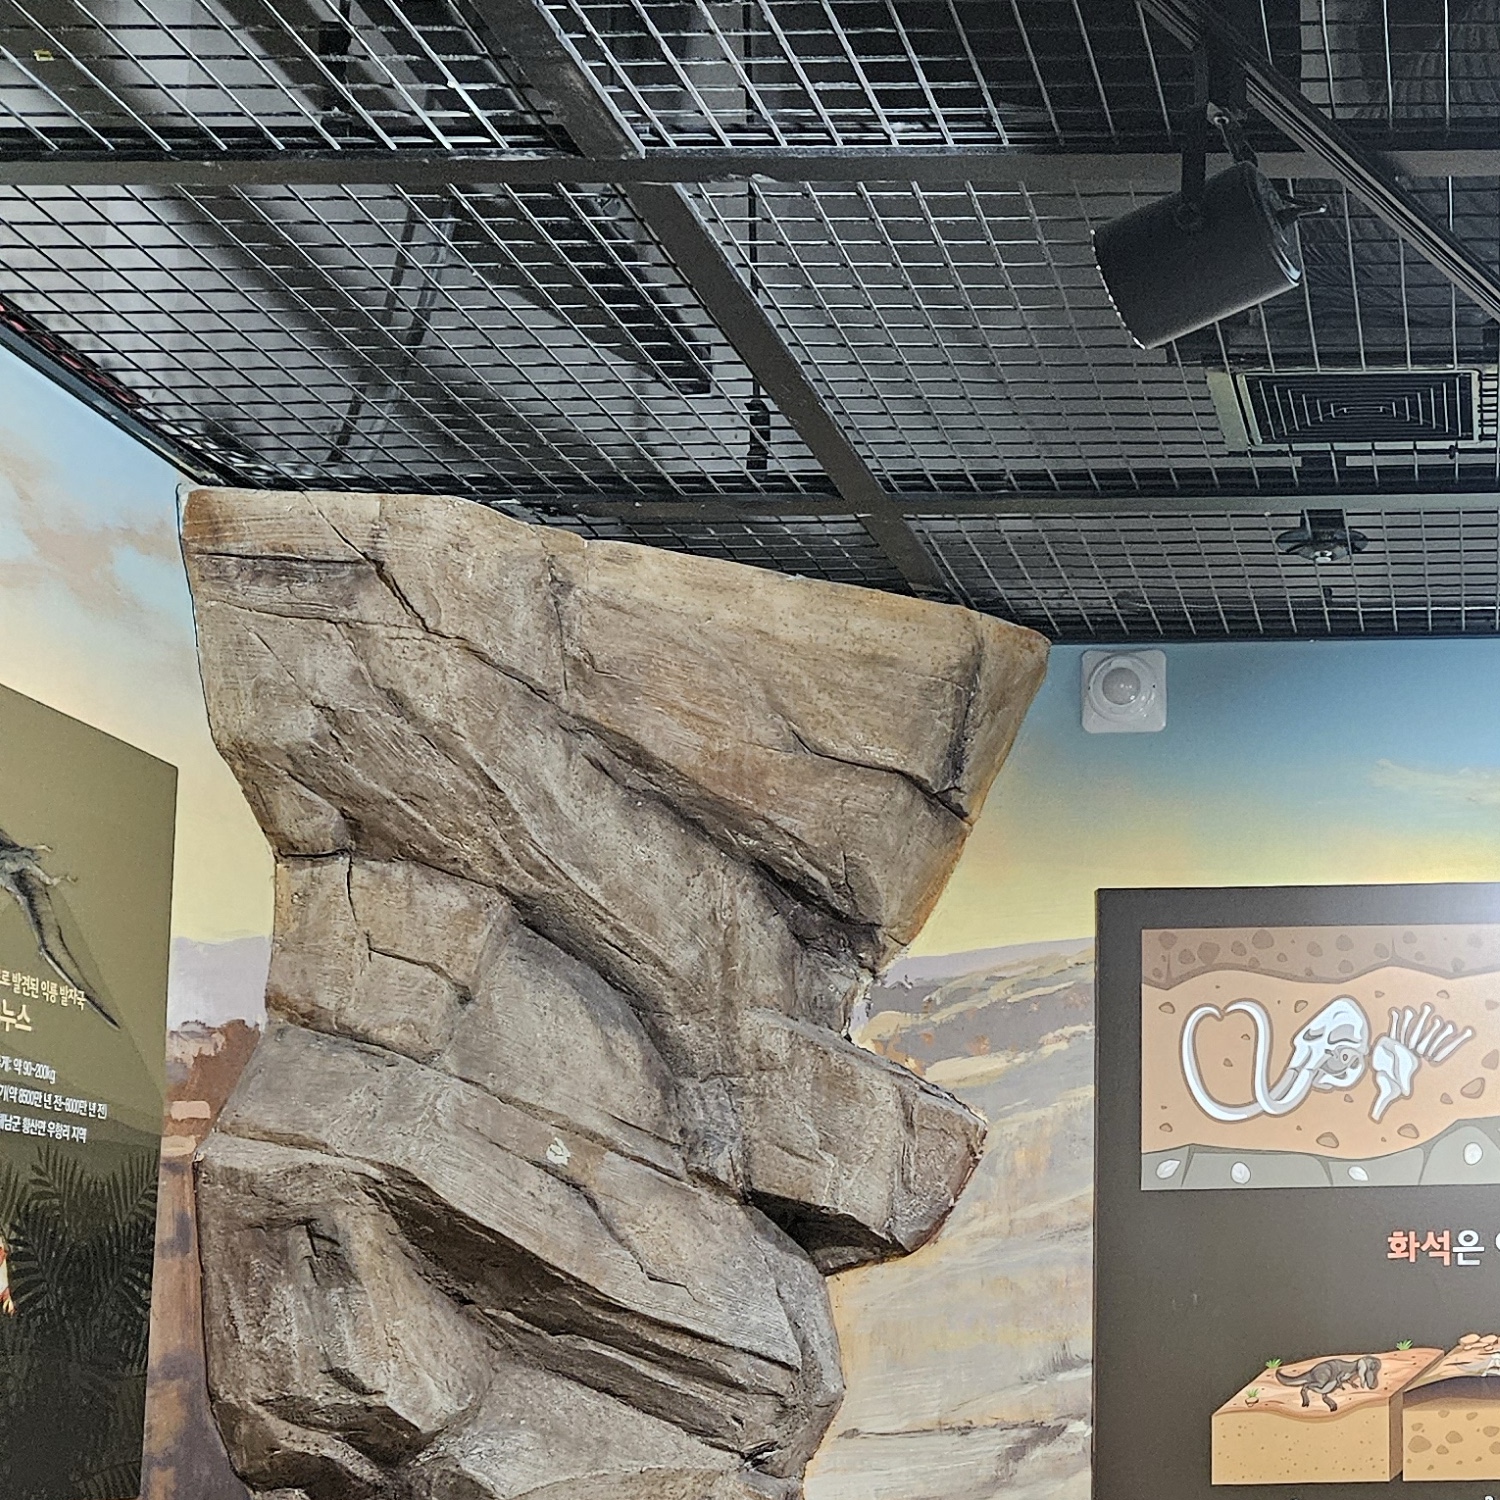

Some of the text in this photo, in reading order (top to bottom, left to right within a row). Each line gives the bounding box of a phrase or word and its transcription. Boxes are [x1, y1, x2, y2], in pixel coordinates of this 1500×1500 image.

[12, 973, 39, 998] 발견된
[41, 981, 58, 1003] 익룡
[60, 985, 87, 1011] 발자국
[1387, 1229, 1485, 1266] 화석은
